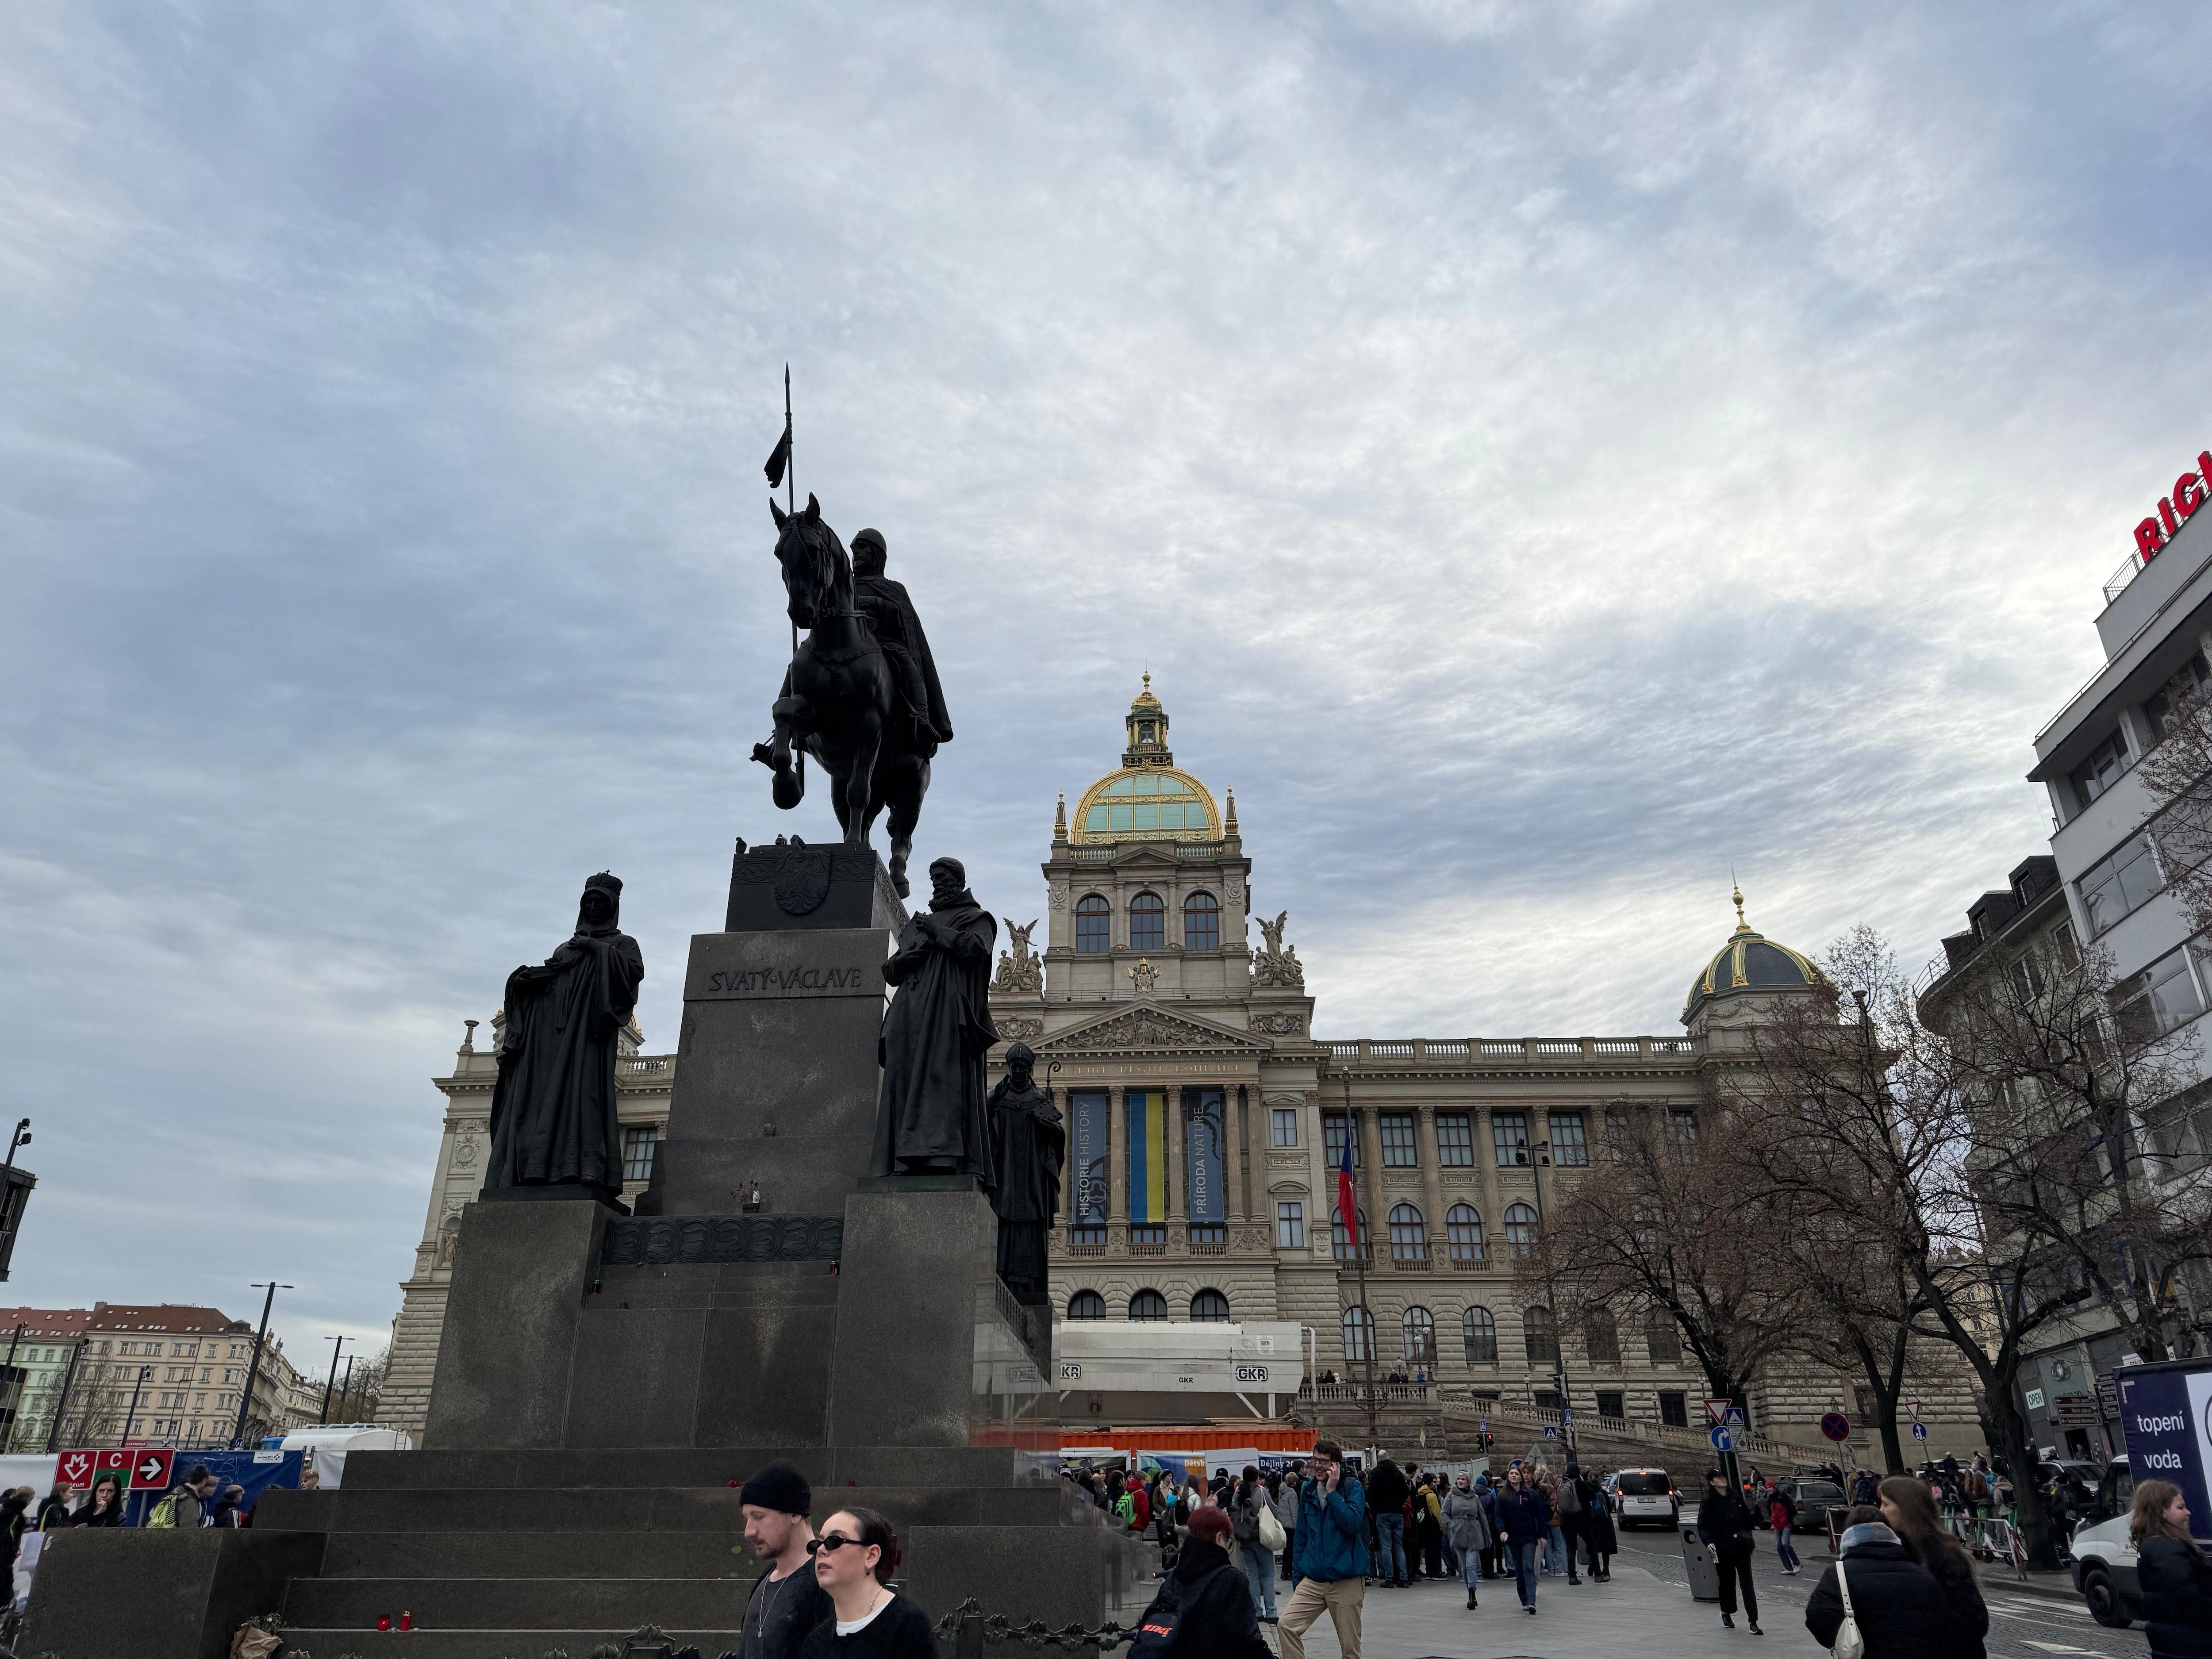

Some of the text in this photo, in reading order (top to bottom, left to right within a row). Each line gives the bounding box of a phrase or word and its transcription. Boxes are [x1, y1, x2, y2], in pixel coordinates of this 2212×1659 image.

[709, 966, 861, 991] SVATÝ VÁCLAVE
[1079, 1101, 1090, 1216] HISTORIE HISTORY
[1194, 1107, 1206, 1214] PŘÍRODA NATURE
[1062, 1367, 1078, 1377] KR
[1239, 1368, 1265, 1379] GKR
[2028, 1392, 2043, 1406] OPEN
[2137, 1410, 2185, 1436] topení
[110, 1453, 122, 1467] C
[1260, 1459, 1284, 1469] Dějiny
[2144, 1449, 2182, 1469] voda
